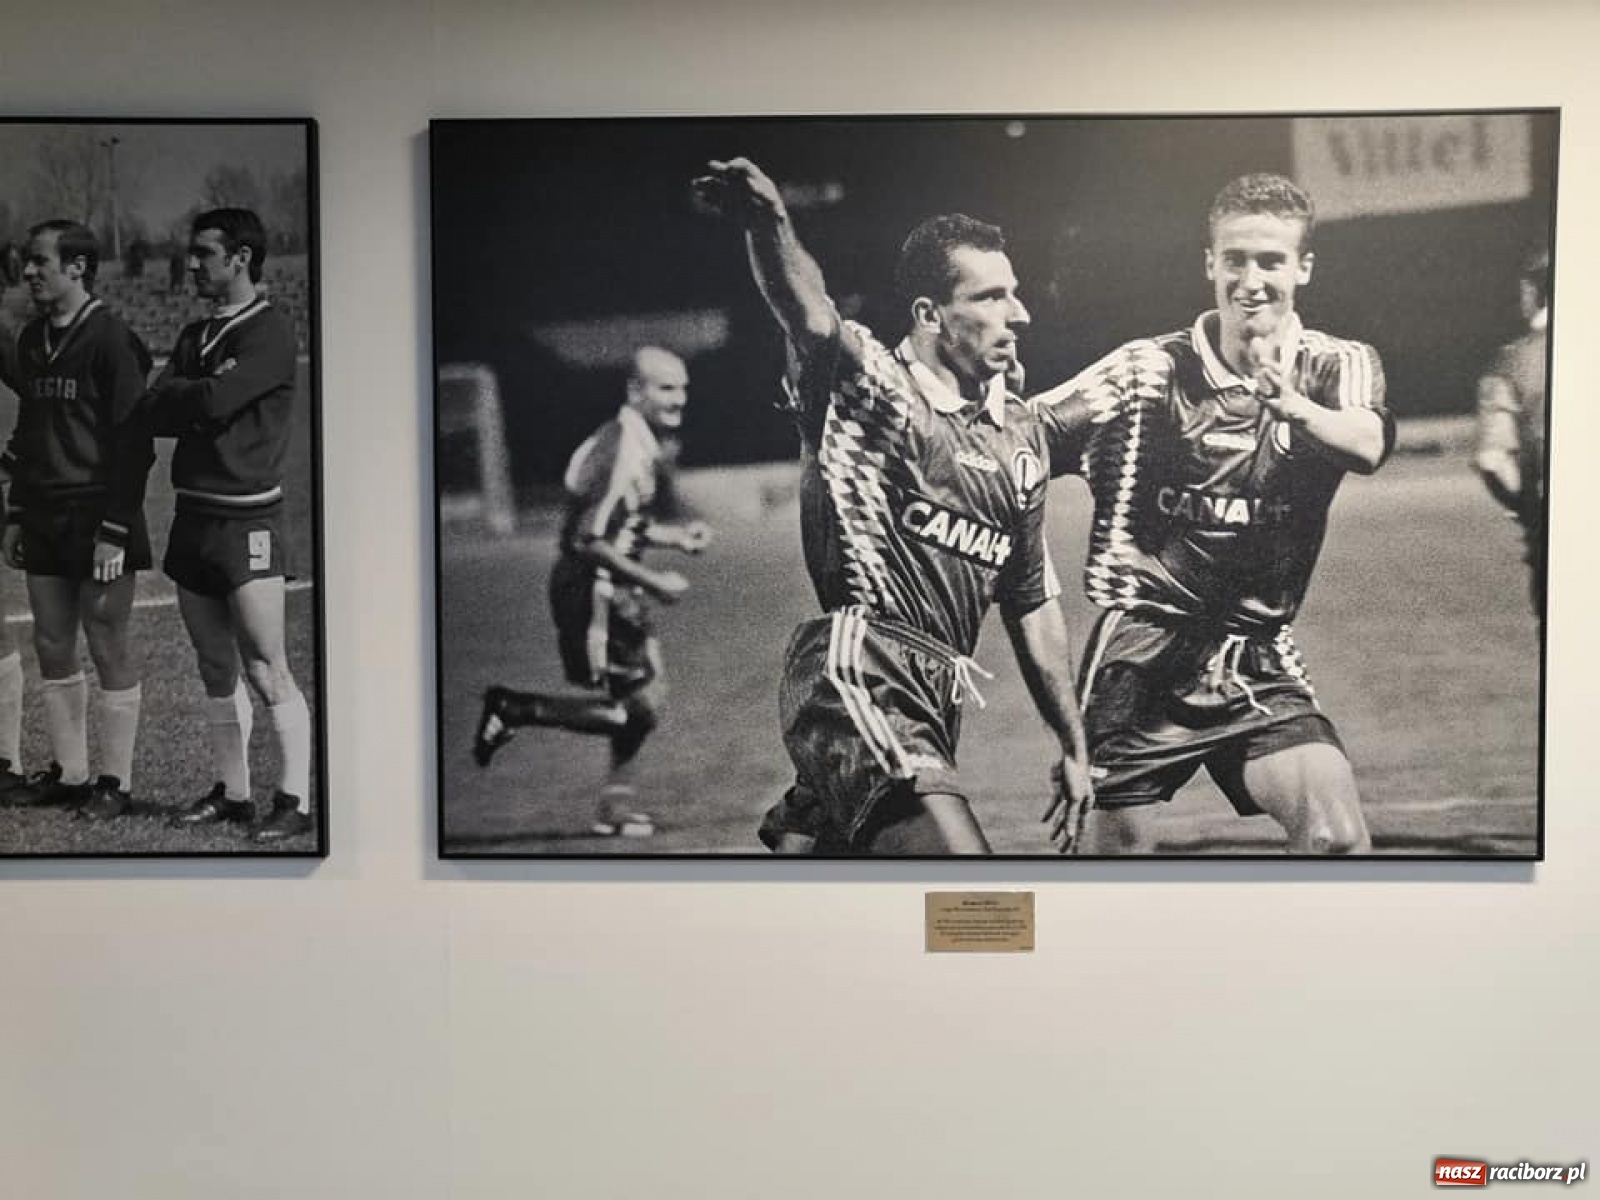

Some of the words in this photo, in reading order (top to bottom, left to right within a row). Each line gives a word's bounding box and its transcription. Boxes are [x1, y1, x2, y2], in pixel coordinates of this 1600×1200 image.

[30, 377, 77, 400] EGIA
[248, 530, 271, 571] 9
[902, 501, 1013, 566] CANAL+
